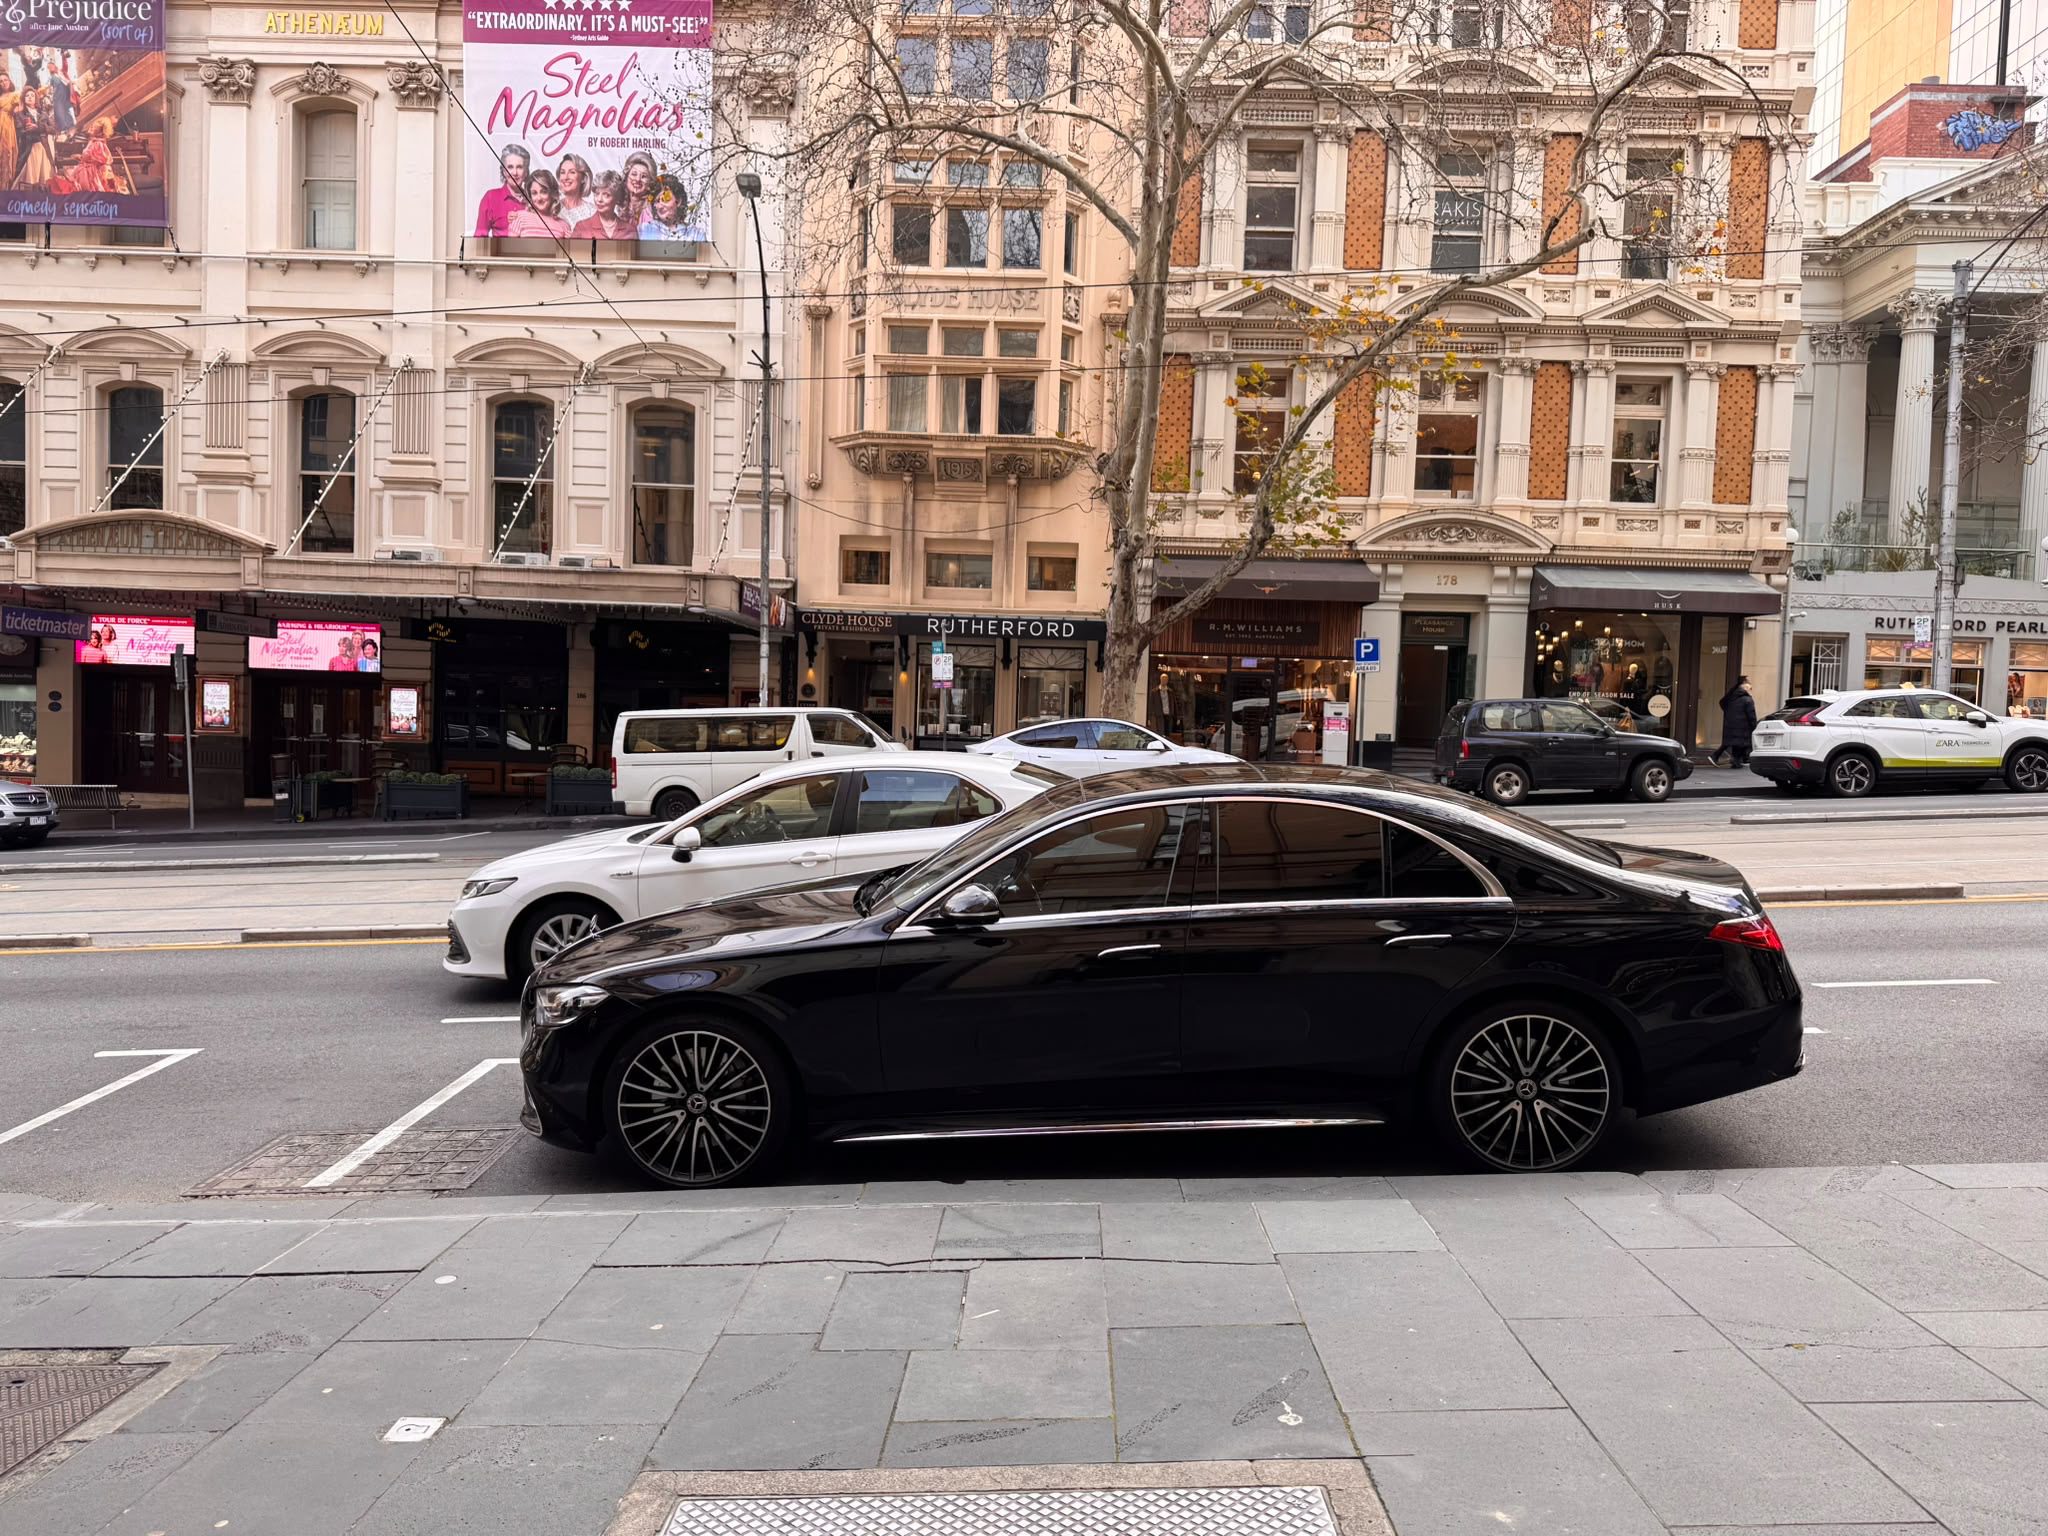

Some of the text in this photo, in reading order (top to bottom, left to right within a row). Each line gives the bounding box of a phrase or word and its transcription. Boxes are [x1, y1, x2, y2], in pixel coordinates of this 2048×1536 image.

[27, 0, 152, 25] Prejudice
[29, 22, 89, 32] after Jane Austen
[618, 17, 628, 32] A
[543, 51, 638, 98] Steel
[487, 86, 685, 156] Magnolias
[588, 137, 666, 149] BY ROBERT HARLING
[7, 197, 118, 221] comedy sensation
[886, 285, 1040, 311] LYDE HOUSE
[1436, 575, 1458, 586] 178
[5, 608, 85, 635] ticketmaster
[801, 613, 893, 628] CLYDE HOUSE
[927, 618, 1075, 637] RUTHERFORD
[1875, 616, 1987, 632] RUTHORD
[841, 625, 880, 633] RESIDENCES
[127, 638, 180, 658] Magnolia
[1361, 642, 1374, 659] P
[943, 655, 952, 663] 2P
[1568, 690, 1581, 698] END
[1594, 691, 1618, 699] SEASON
